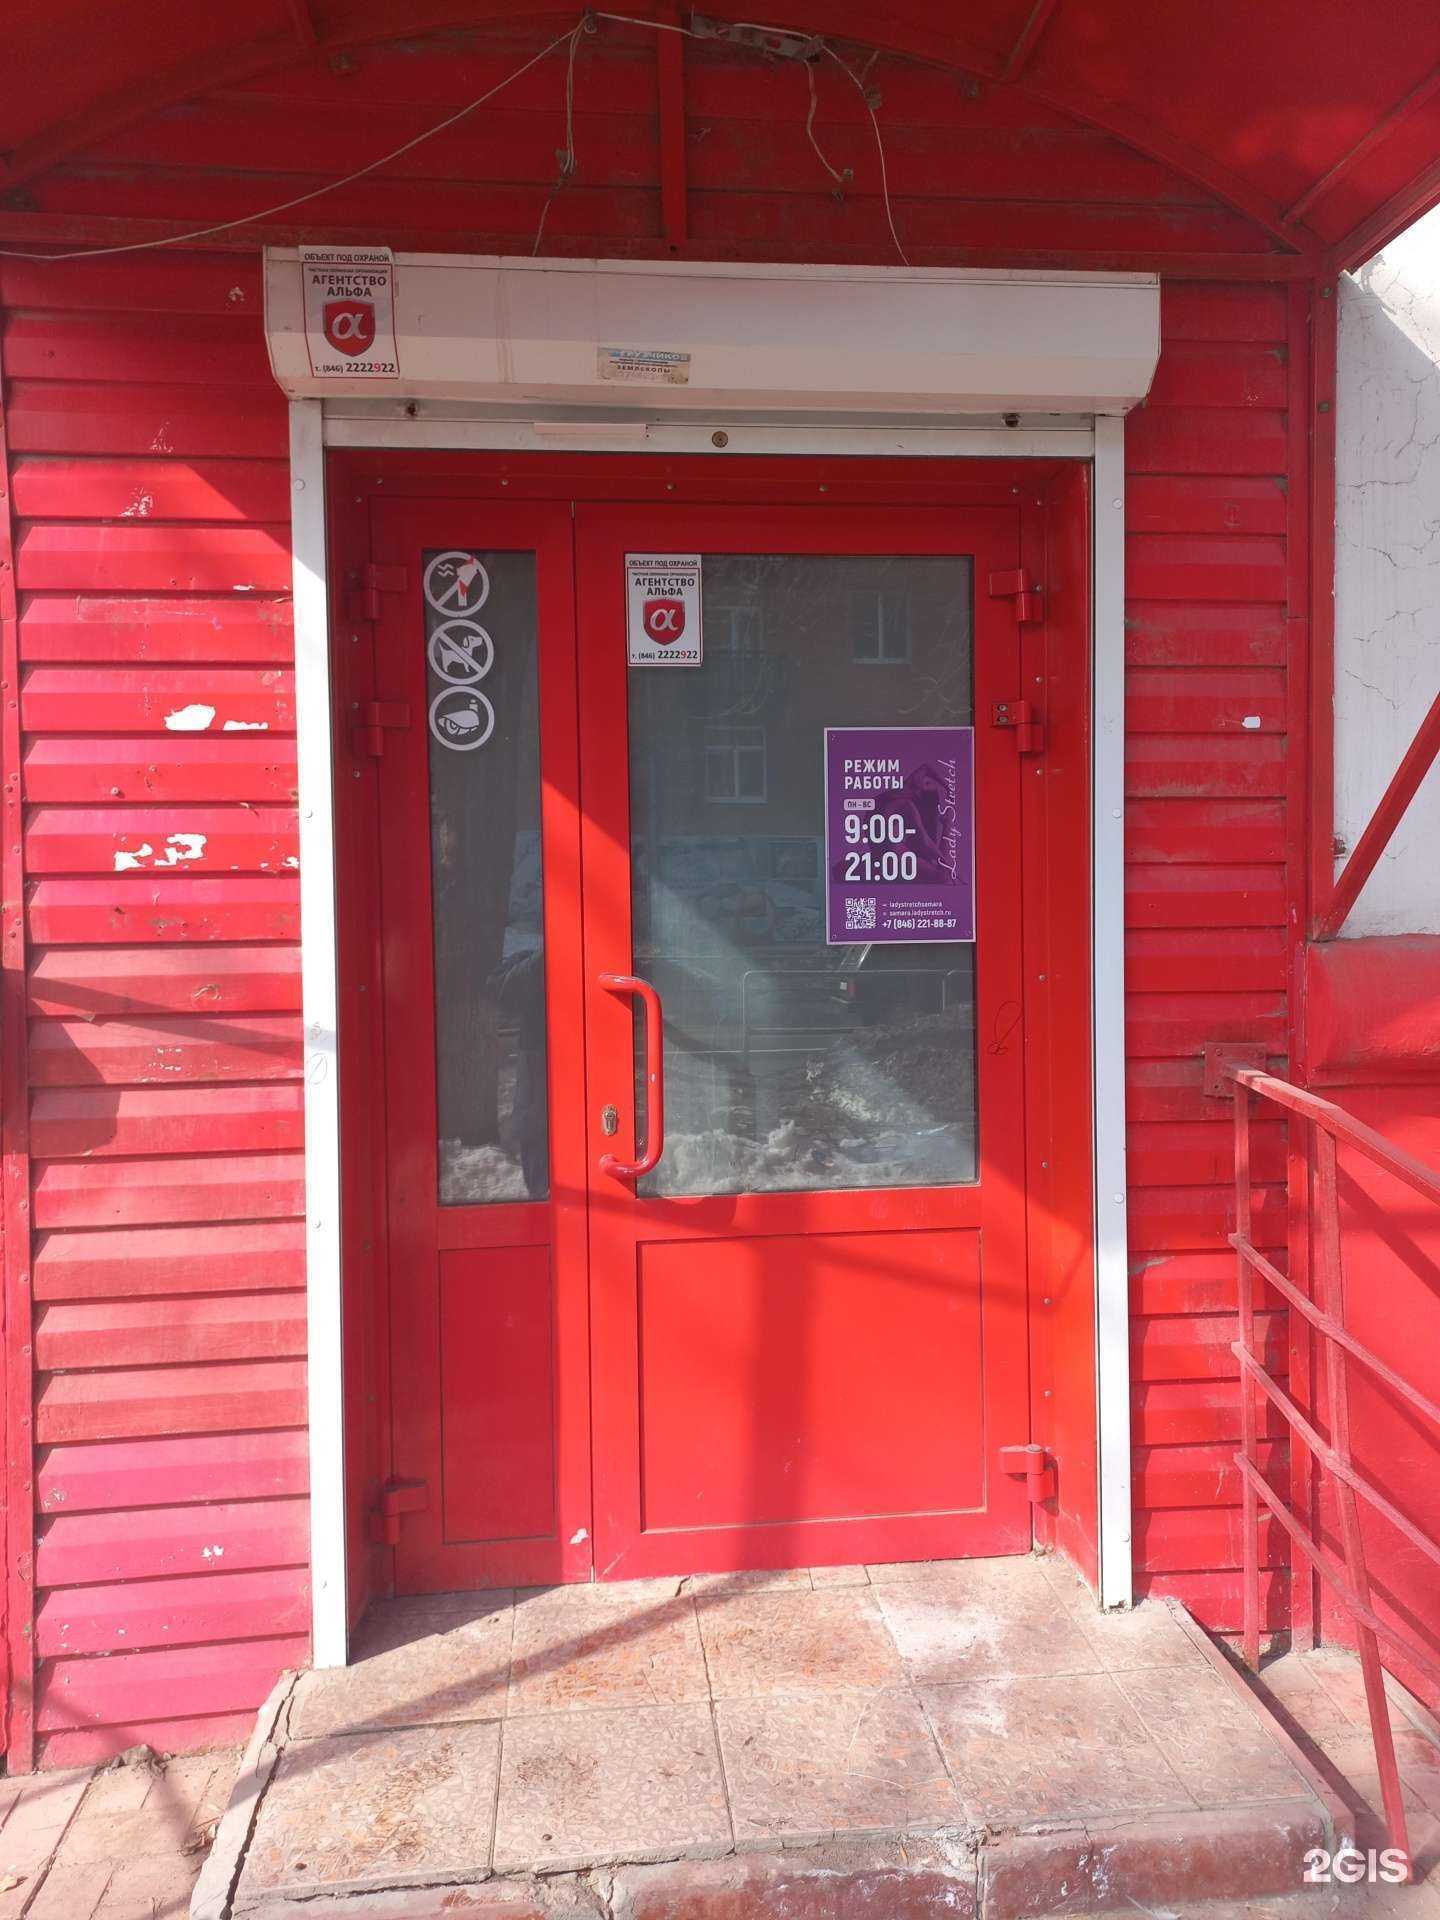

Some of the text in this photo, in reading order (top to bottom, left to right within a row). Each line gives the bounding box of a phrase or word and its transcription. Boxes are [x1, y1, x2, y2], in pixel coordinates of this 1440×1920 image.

[304, 252, 335, 261] ОБЪЕКТ
[336, 254, 352, 262] ПОД
[312, 274, 387, 287] АГЕНТСТВО
[327, 286, 372, 298] АЛЬФА
[322, 364, 343, 373] (846)
[345, 362, 396, 373] 2222922
[635, 577, 695, 587] АГЕНТСТВО
[647, 587, 683, 596] АЛЬФА
[638, 652, 656, 660] (846)
[657, 650, 698, 659] 2222922
[844, 759, 900, 773] РЕЖИМ
[844, 775, 904, 790] РАБОТЫ
[847, 800, 858, 809] ПН
[863, 800, 872, 809] ВС
[937, 759, 962, 880] Lady Stretch
[844, 813, 916, 844] 9:00-
[845, 851, 917, 881] 21:00
[882, 918, 957, 929] +7 (846) 221-88-87
